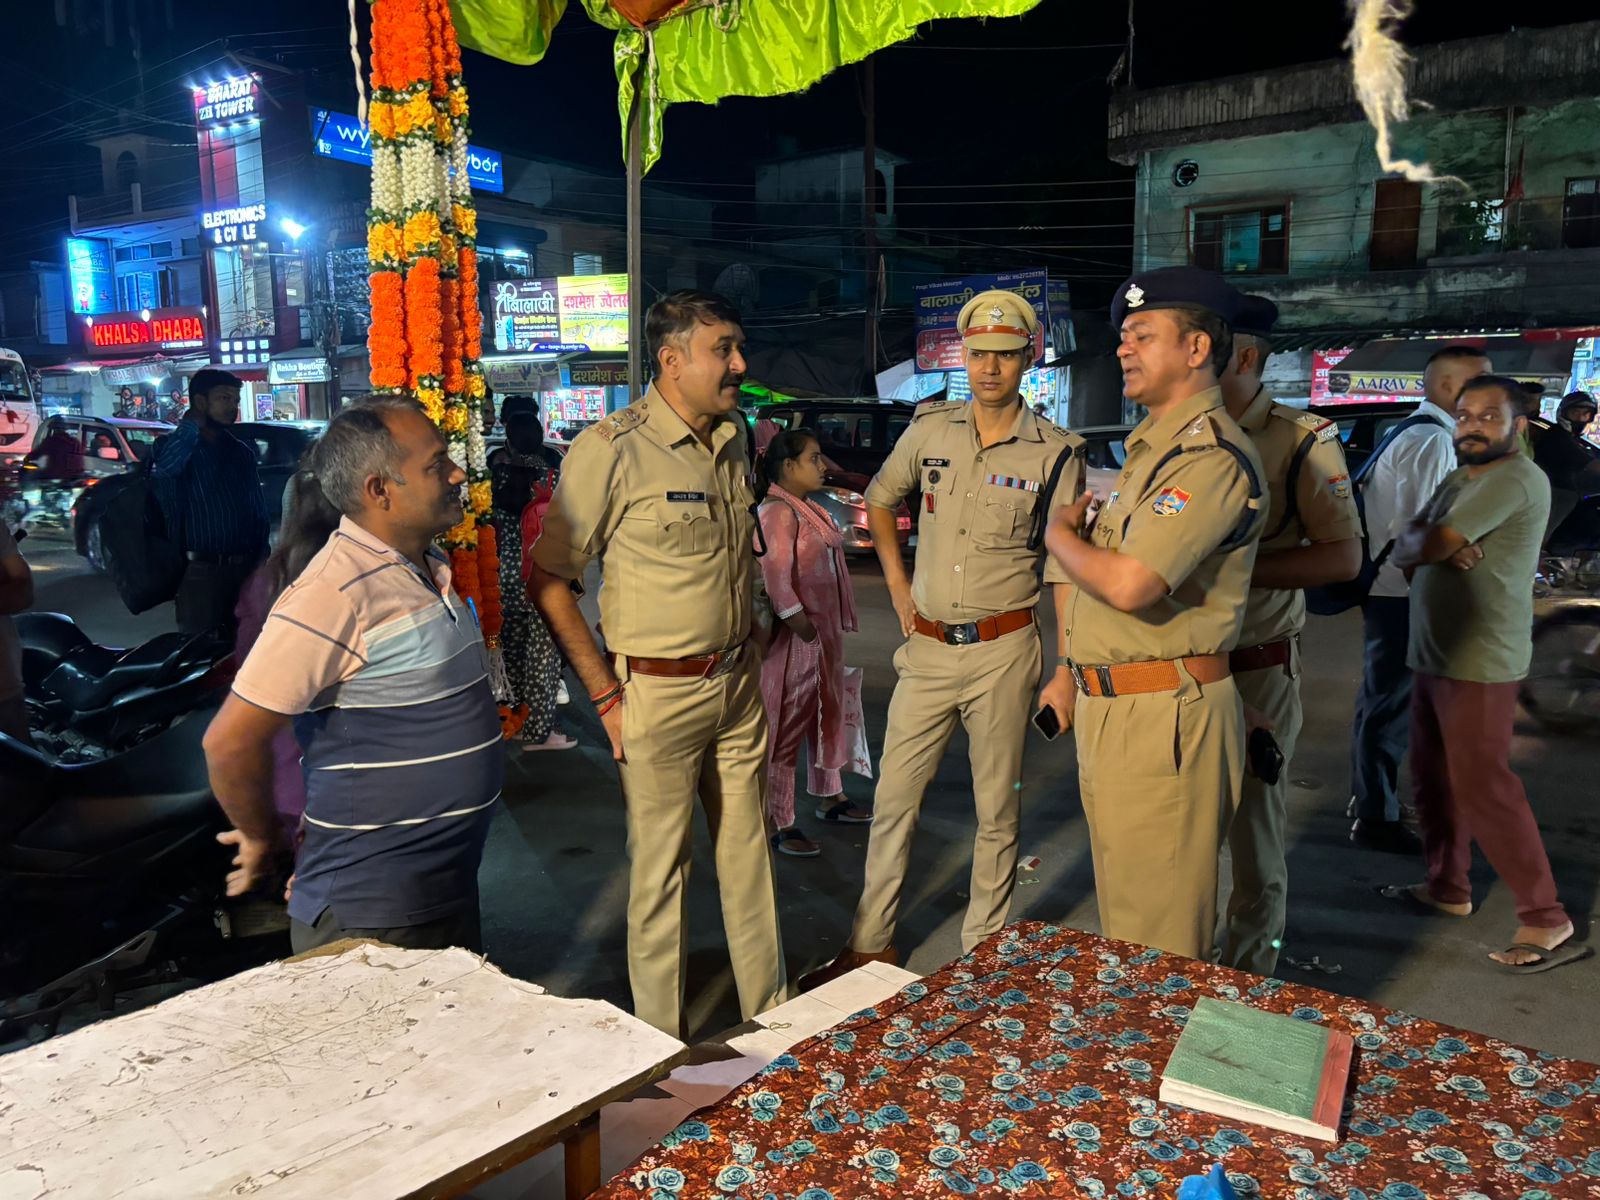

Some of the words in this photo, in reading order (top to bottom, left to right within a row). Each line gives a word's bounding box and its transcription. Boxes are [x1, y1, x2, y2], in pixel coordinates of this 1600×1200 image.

[207, 76, 253, 104] BHARAT
[214, 96, 255, 119] TOWER
[203, 204, 267, 228] ELECTRONICS
[224, 223, 257, 242] CYLE
[94, 323, 149, 345] KHALSA
[153, 318, 203, 342] DHABA
[572, 366, 612, 382] दशमेश
[1356, 378, 1408, 392] AARAV
